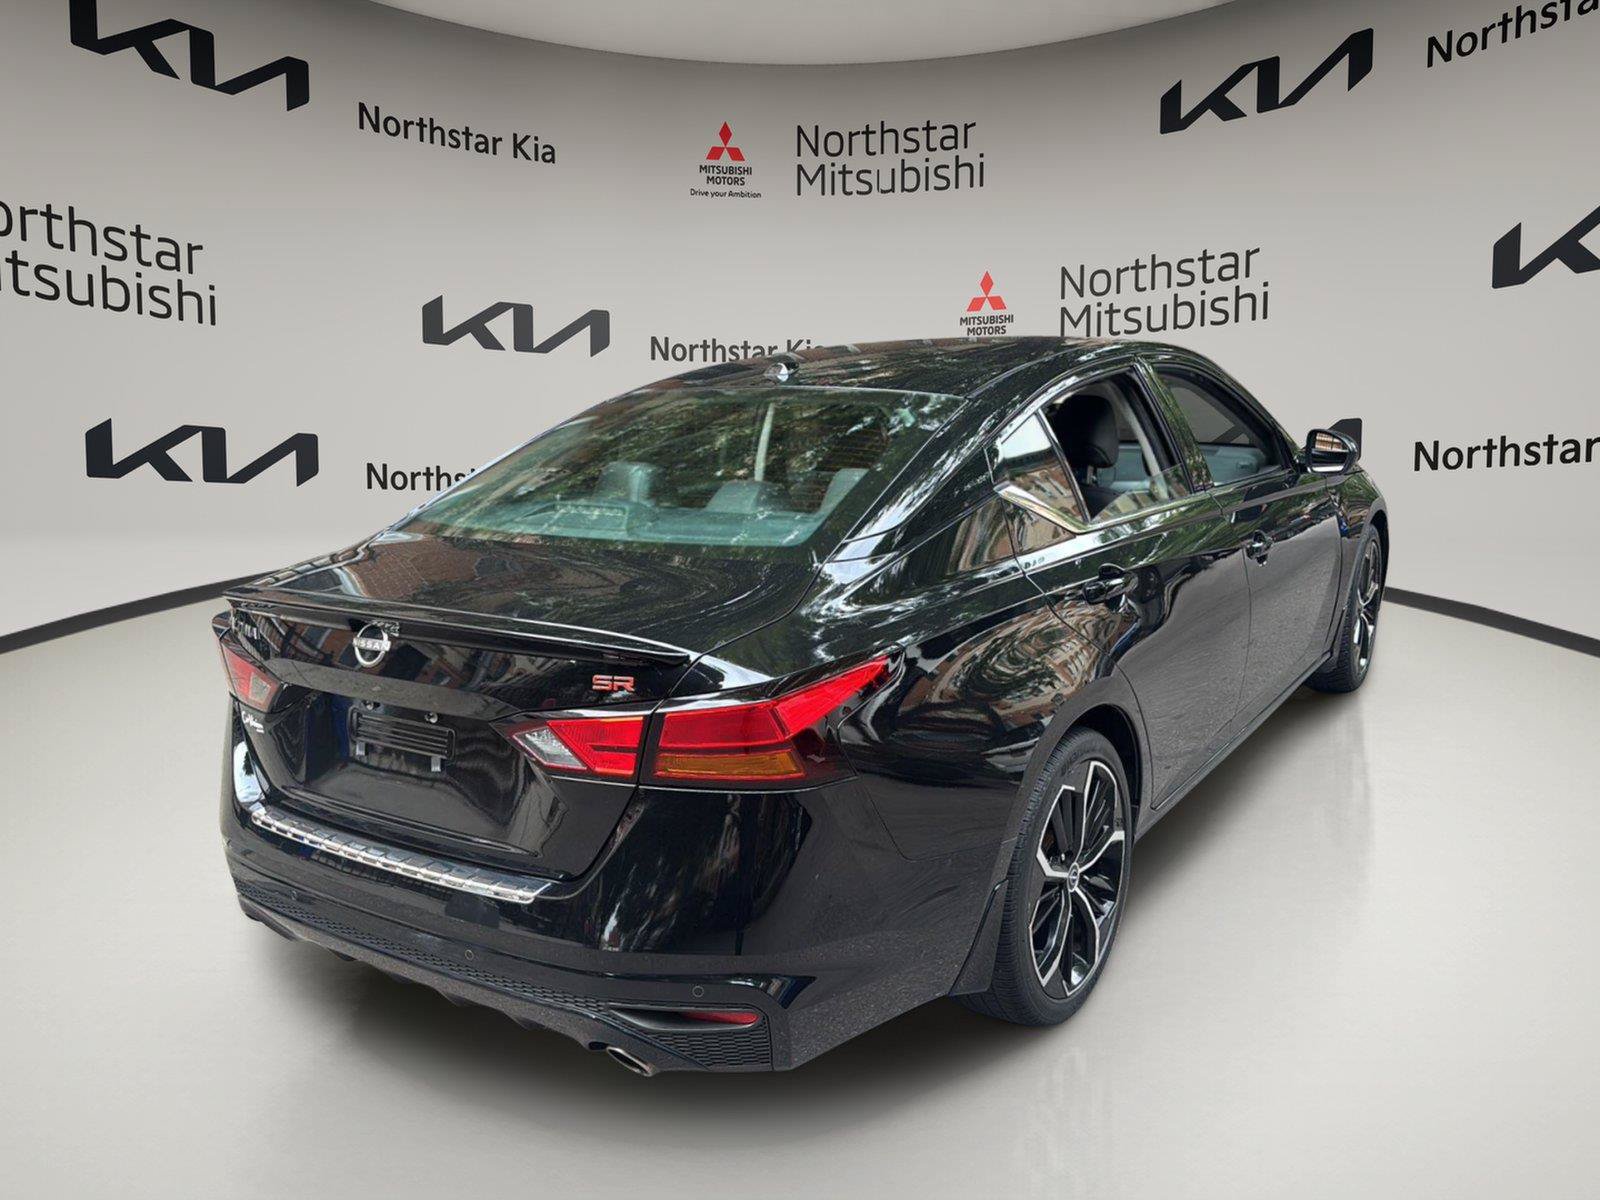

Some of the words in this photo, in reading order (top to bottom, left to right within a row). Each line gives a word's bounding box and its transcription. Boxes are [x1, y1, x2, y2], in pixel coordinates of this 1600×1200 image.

[358, 101, 505, 157] Northstar
[512, 132, 557, 165] Kia
[796, 120, 977, 158] Northstar
[699, 165, 752, 175] MITSUBISHI
[706, 175, 746, 186] MOTORS
[796, 153, 985, 197] Mitsubishi
[690, 188, 709, 196] Drive
[728, 190, 762, 198] Ambition
[1060, 247, 1261, 300] Northstar
[960, 314, 1014, 326] MITSUBISHI
[1060, 281, 1269, 338] Mitsubishi
[967, 325, 1007, 336] MOTORS
[1413, 434, 1600, 472] Northstar
[592, 674, 636, 692] SR
